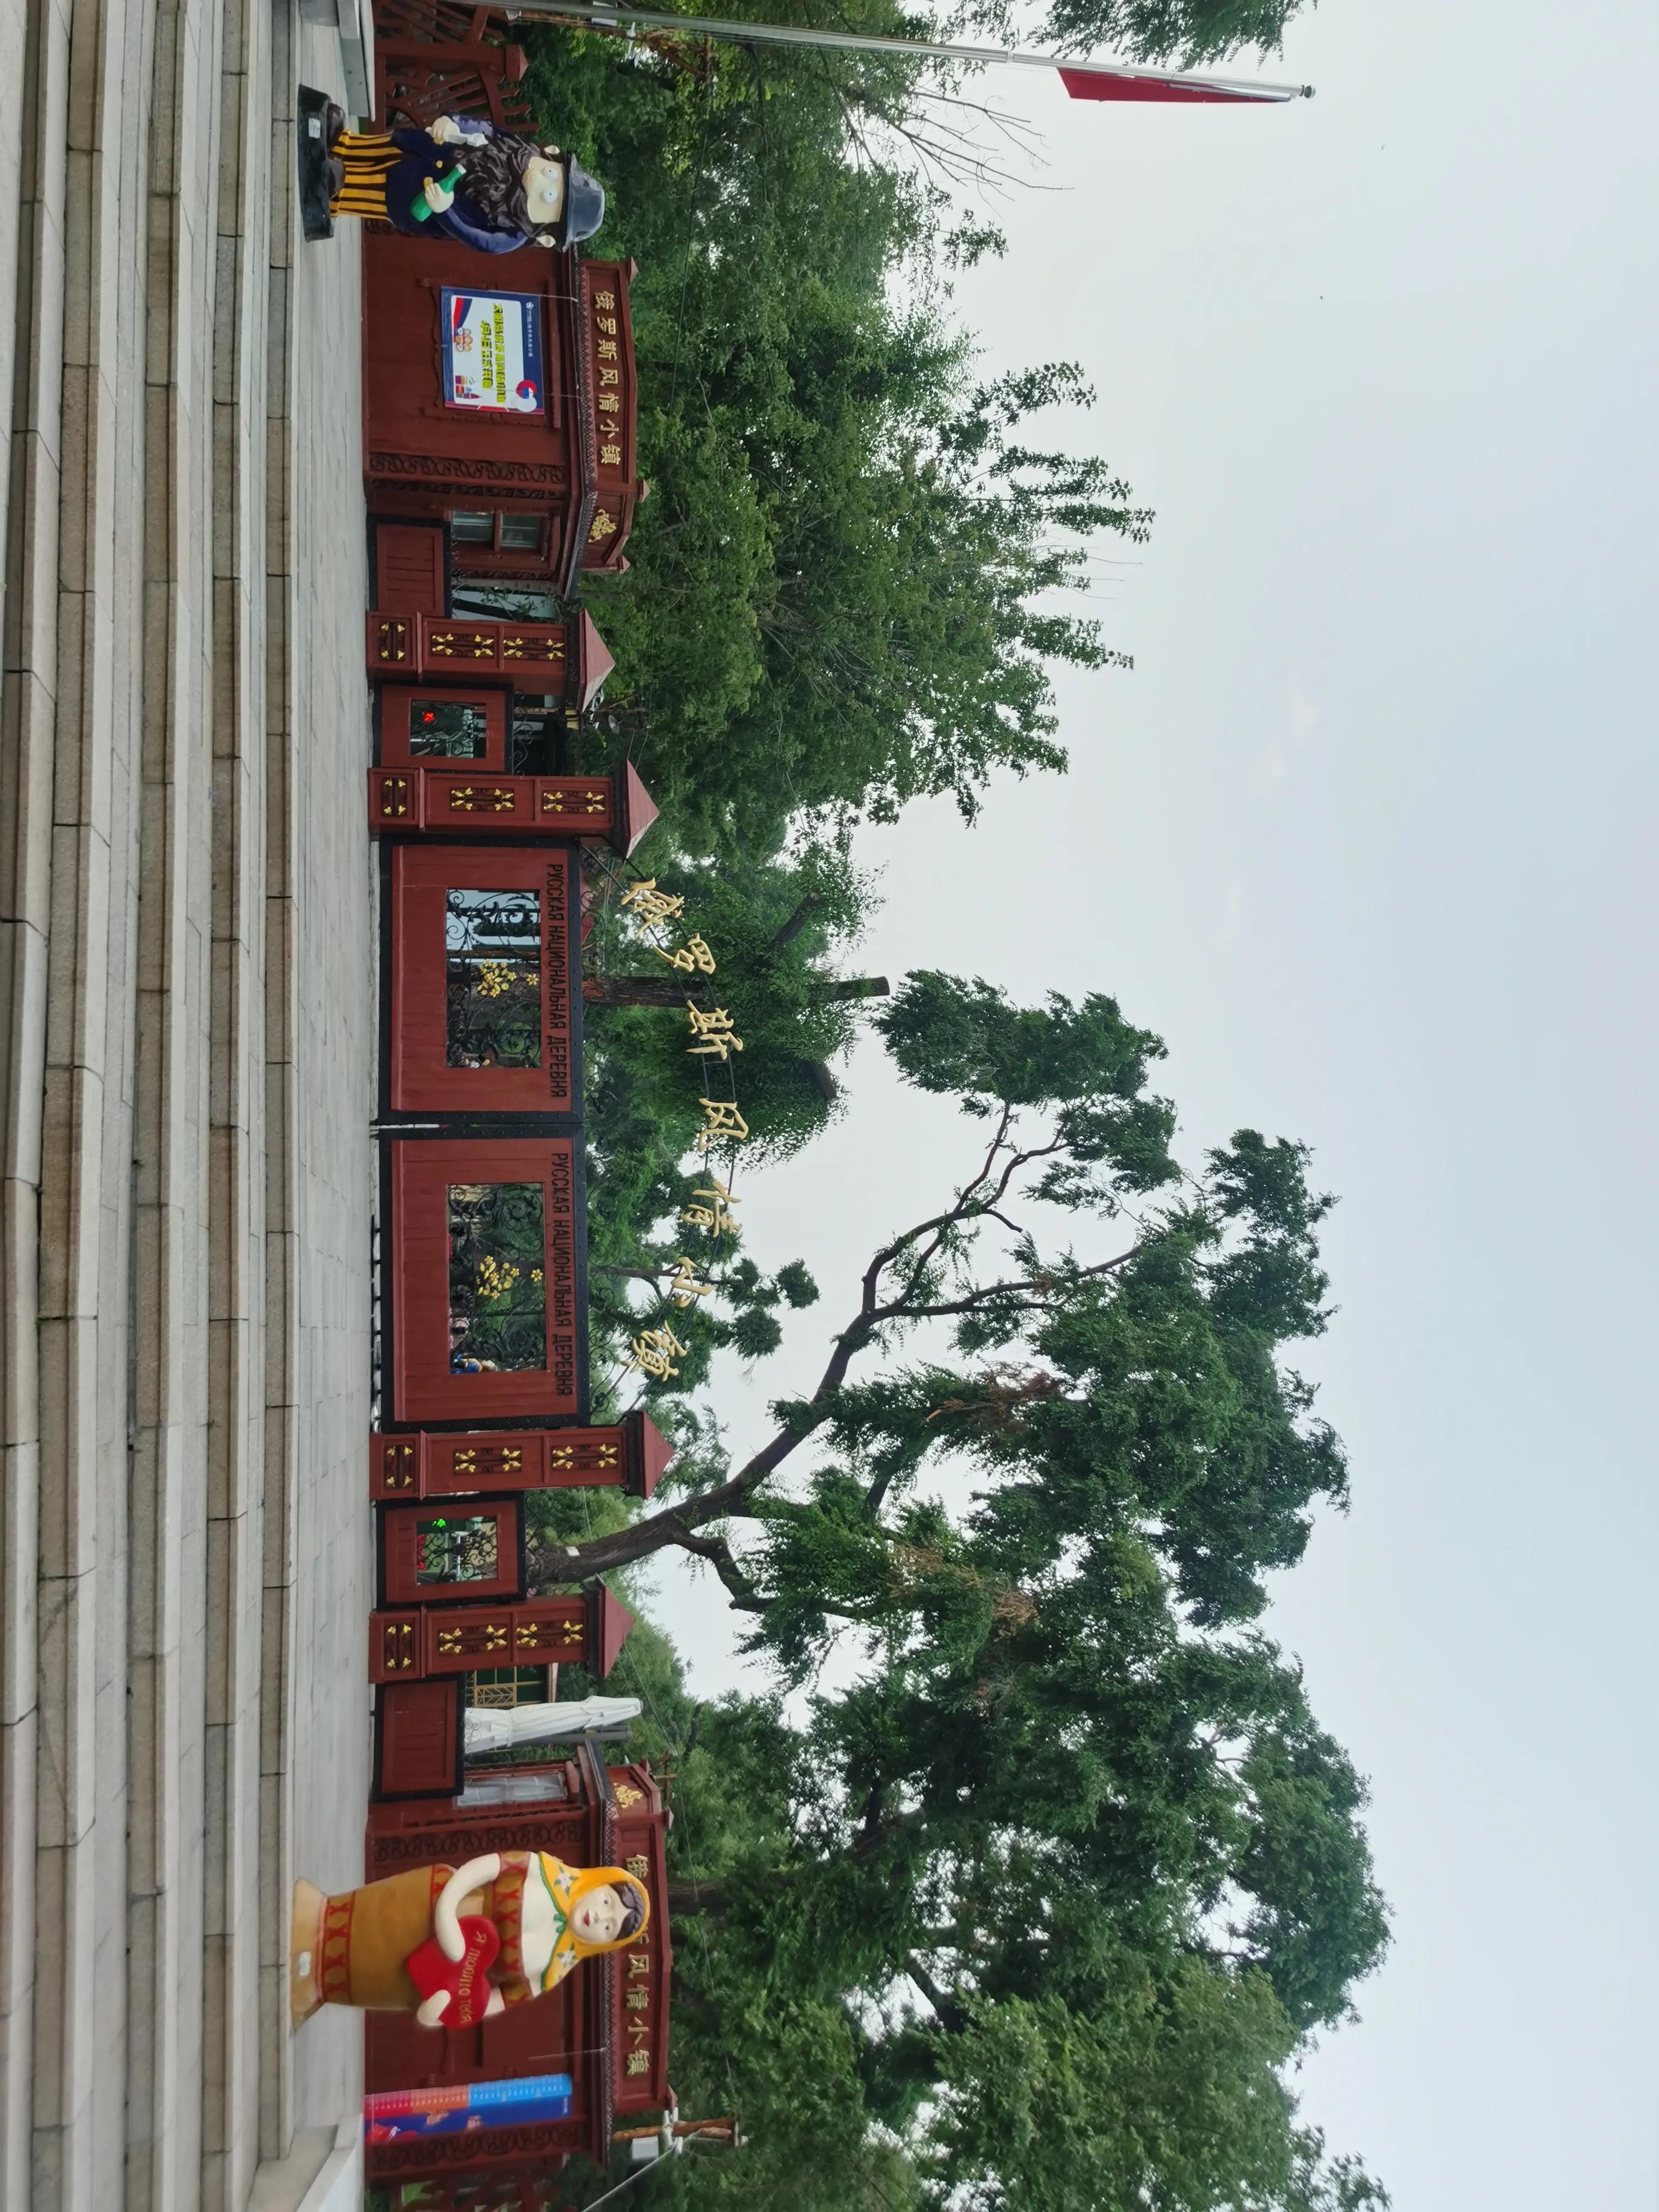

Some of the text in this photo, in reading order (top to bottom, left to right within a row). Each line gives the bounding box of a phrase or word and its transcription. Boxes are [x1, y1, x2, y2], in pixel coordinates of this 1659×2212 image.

[594, 290, 622, 465] 俄罗斯风情小镇
[545, 863, 568, 1098] РУССКАЯ НАЦИОНАЛЬНАЯ ДЕРЕВНЯ
[619, 876, 749, 1382] 俄罗斯风情小镇
[551, 1153, 574, 1395] РУССКАЯ НАЦИОНАЛЬНАЯ ДЕРЕВНЯ
[472, 1931, 487, 1945] Я
[625, 1854, 651, 2076] 俄风情小镇
